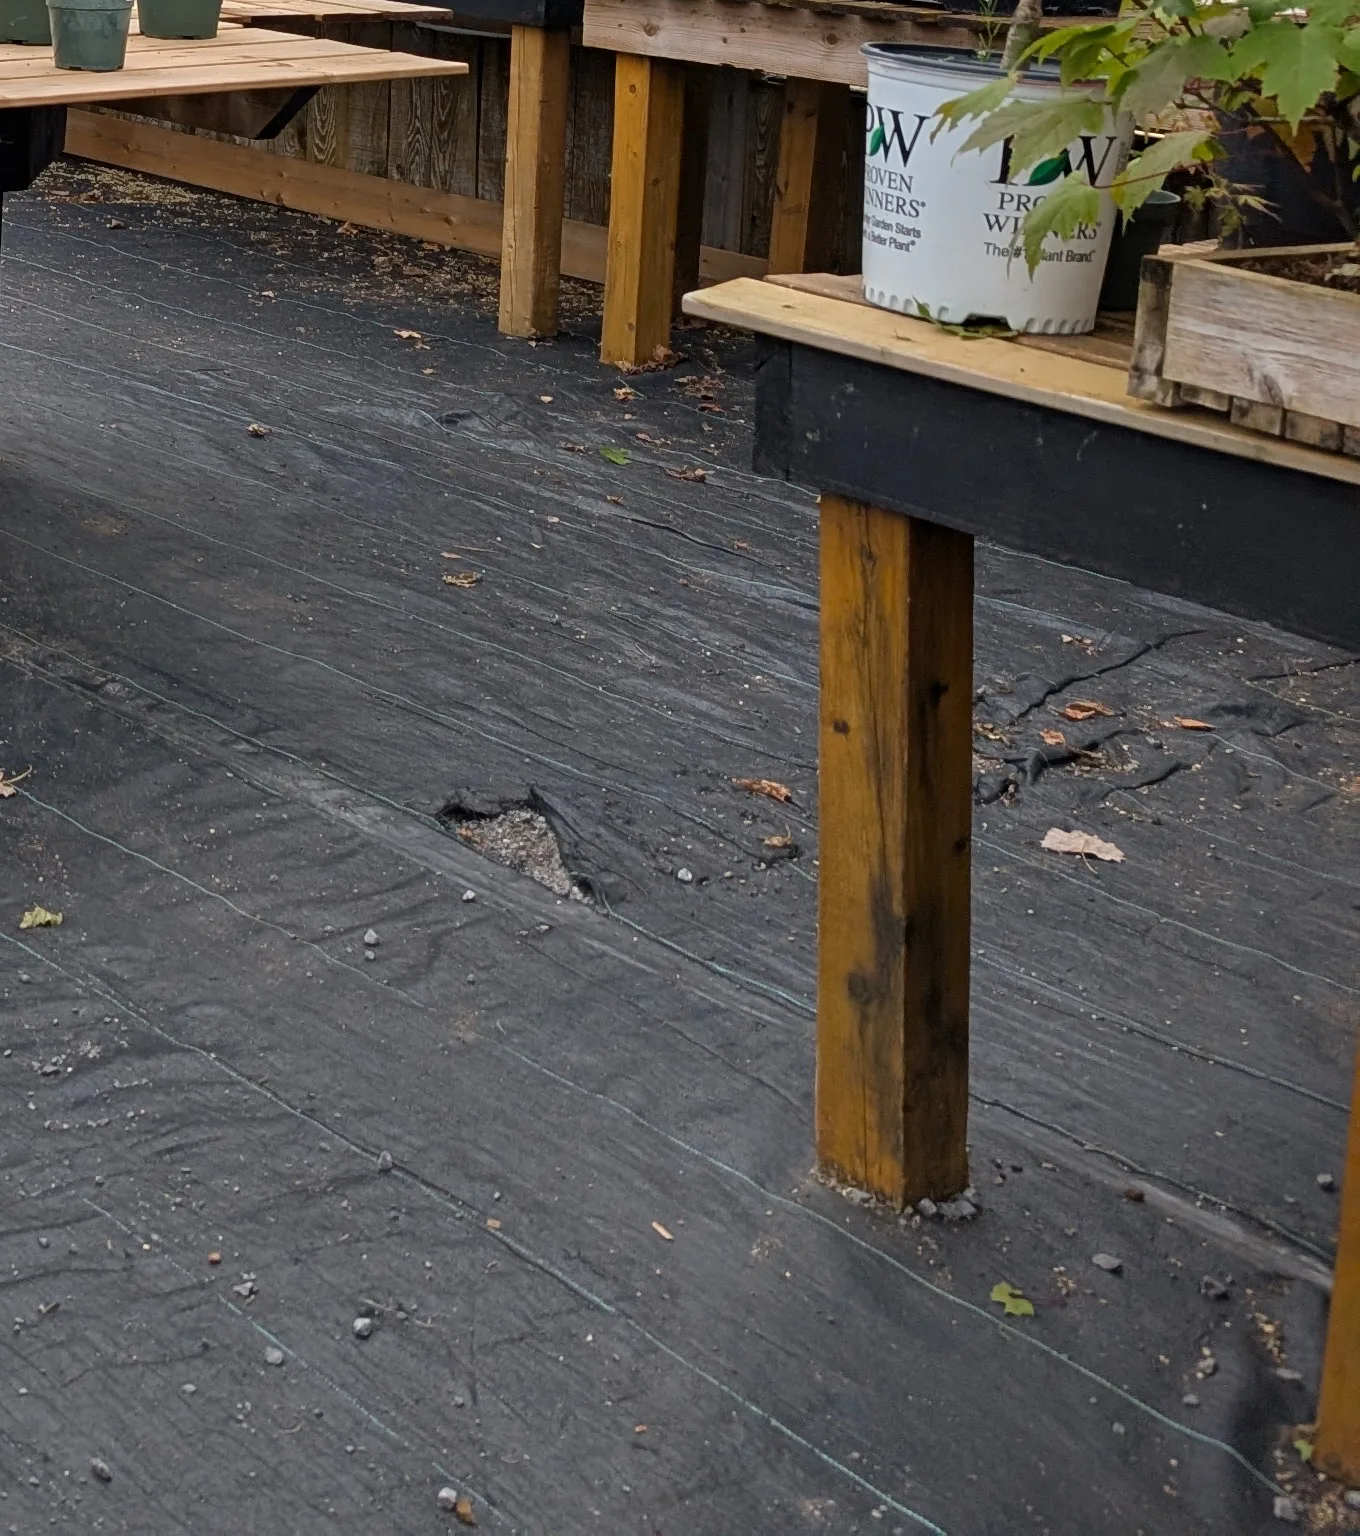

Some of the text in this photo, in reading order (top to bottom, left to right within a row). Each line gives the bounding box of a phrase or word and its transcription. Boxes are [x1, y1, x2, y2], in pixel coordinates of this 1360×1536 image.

[865, 164, 914, 194] ROVEN
[895, 222, 922, 239] Starts
[889, 236, 911, 252] Plant
[984, 242, 1010, 257] The
[1065, 250, 1093, 263] Brand
